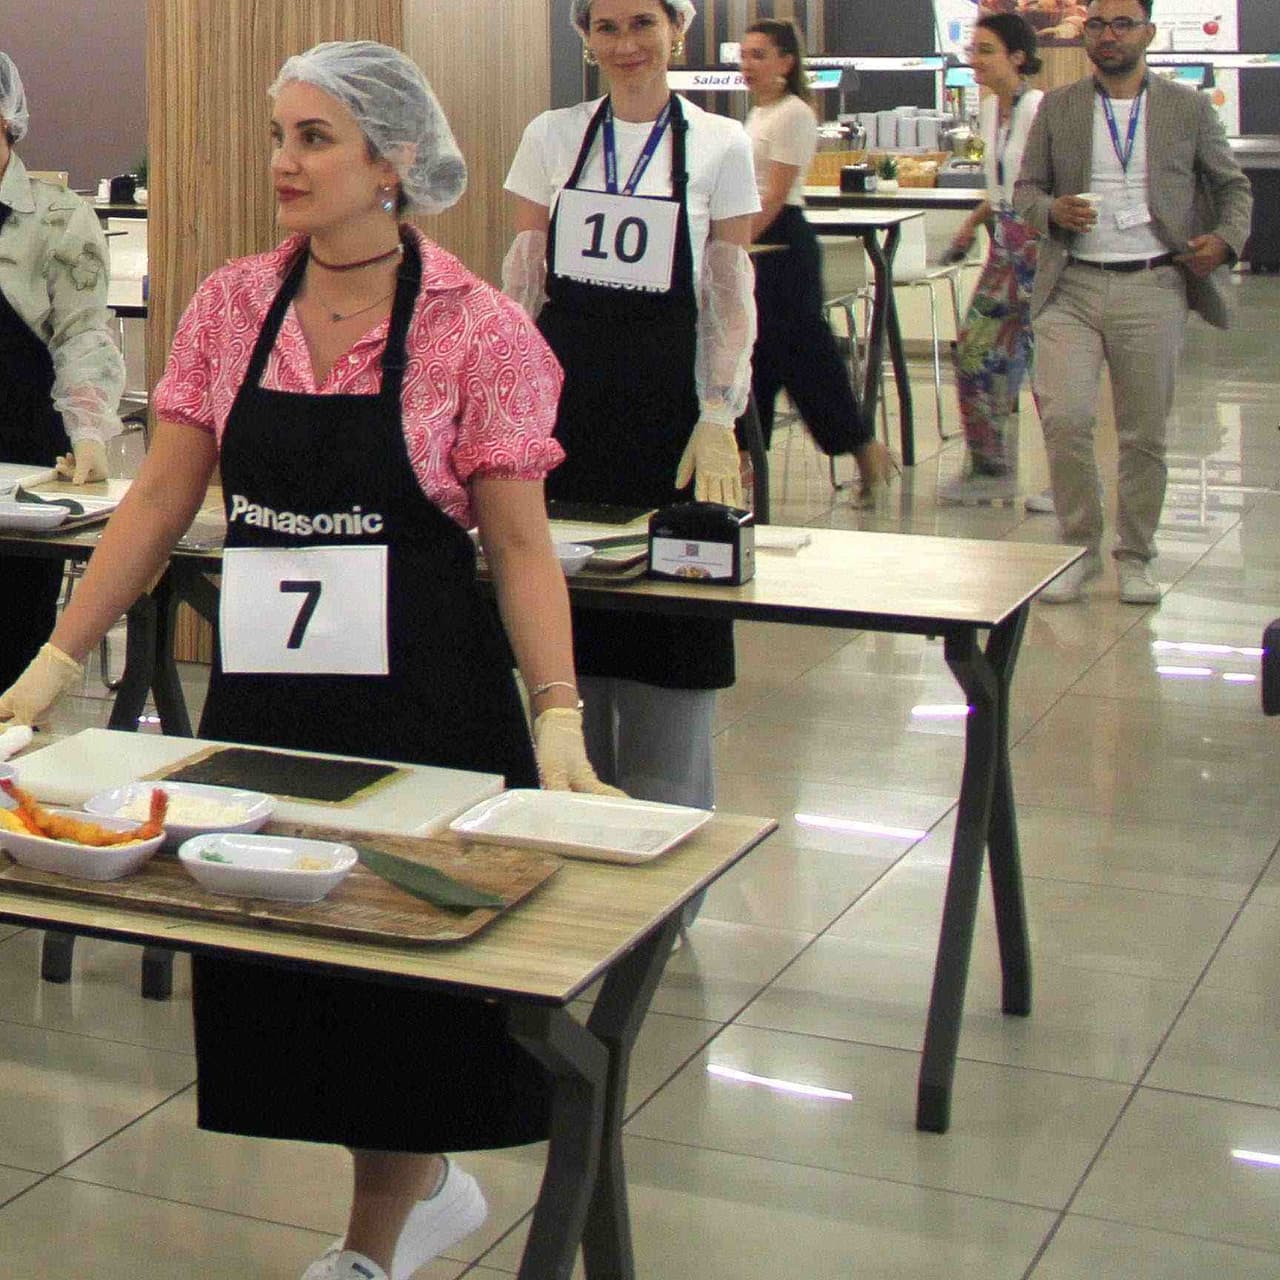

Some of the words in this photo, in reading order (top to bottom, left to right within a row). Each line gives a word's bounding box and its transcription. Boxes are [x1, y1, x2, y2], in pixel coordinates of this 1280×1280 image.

[692, 75, 730, 85] Salad
[581, 212, 648, 263] 10
[230, 494, 384, 535] Panasonic
[280, 580, 322, 649] 7
